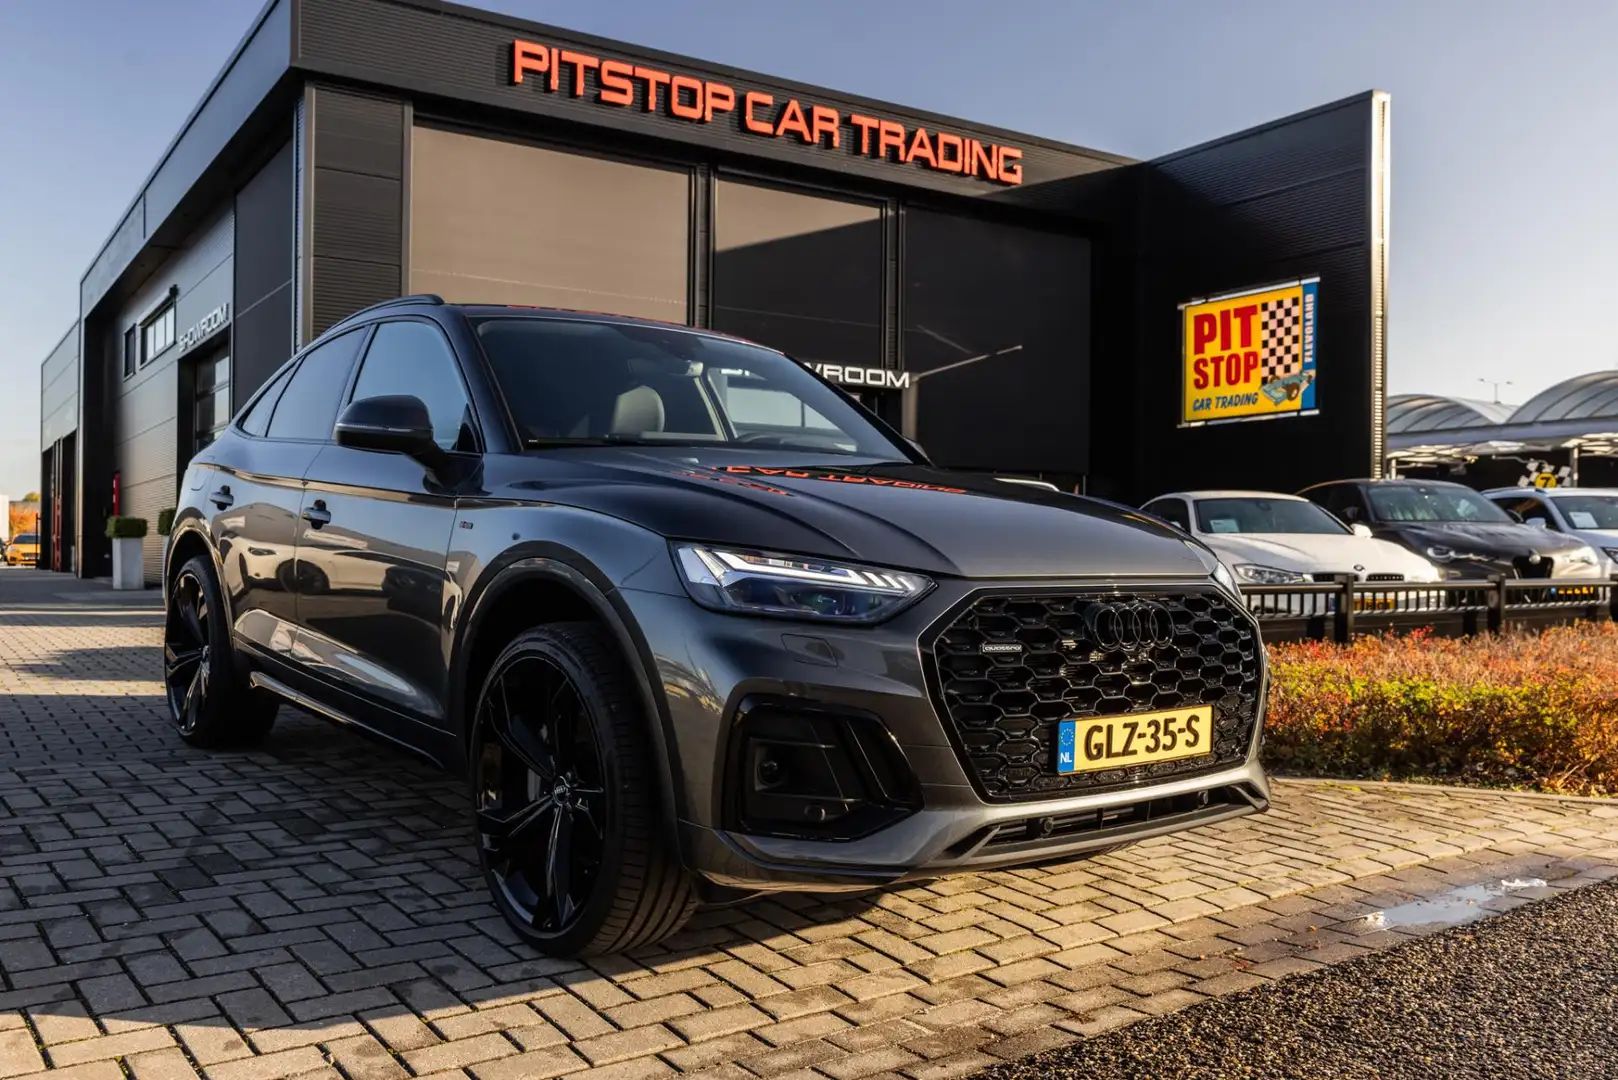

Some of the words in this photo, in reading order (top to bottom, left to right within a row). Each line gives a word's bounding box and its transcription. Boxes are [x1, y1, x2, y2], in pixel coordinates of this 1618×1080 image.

[513, 39, 735, 123] PITSTOP
[744, 91, 840, 149] CAR
[850, 113, 1023, 185] TRADING
[1193, 304, 1258, 355] PIT
[1304, 293, 1315, 363] FLEVOLAND
[1193, 351, 1258, 390] STOP
[1192, 396, 1212, 412] CAR
[1214, 392, 1259, 409] TRADING
[1059, 752, 1073, 764] NL
[1084, 714, 1200, 761] GLZ-35-S
